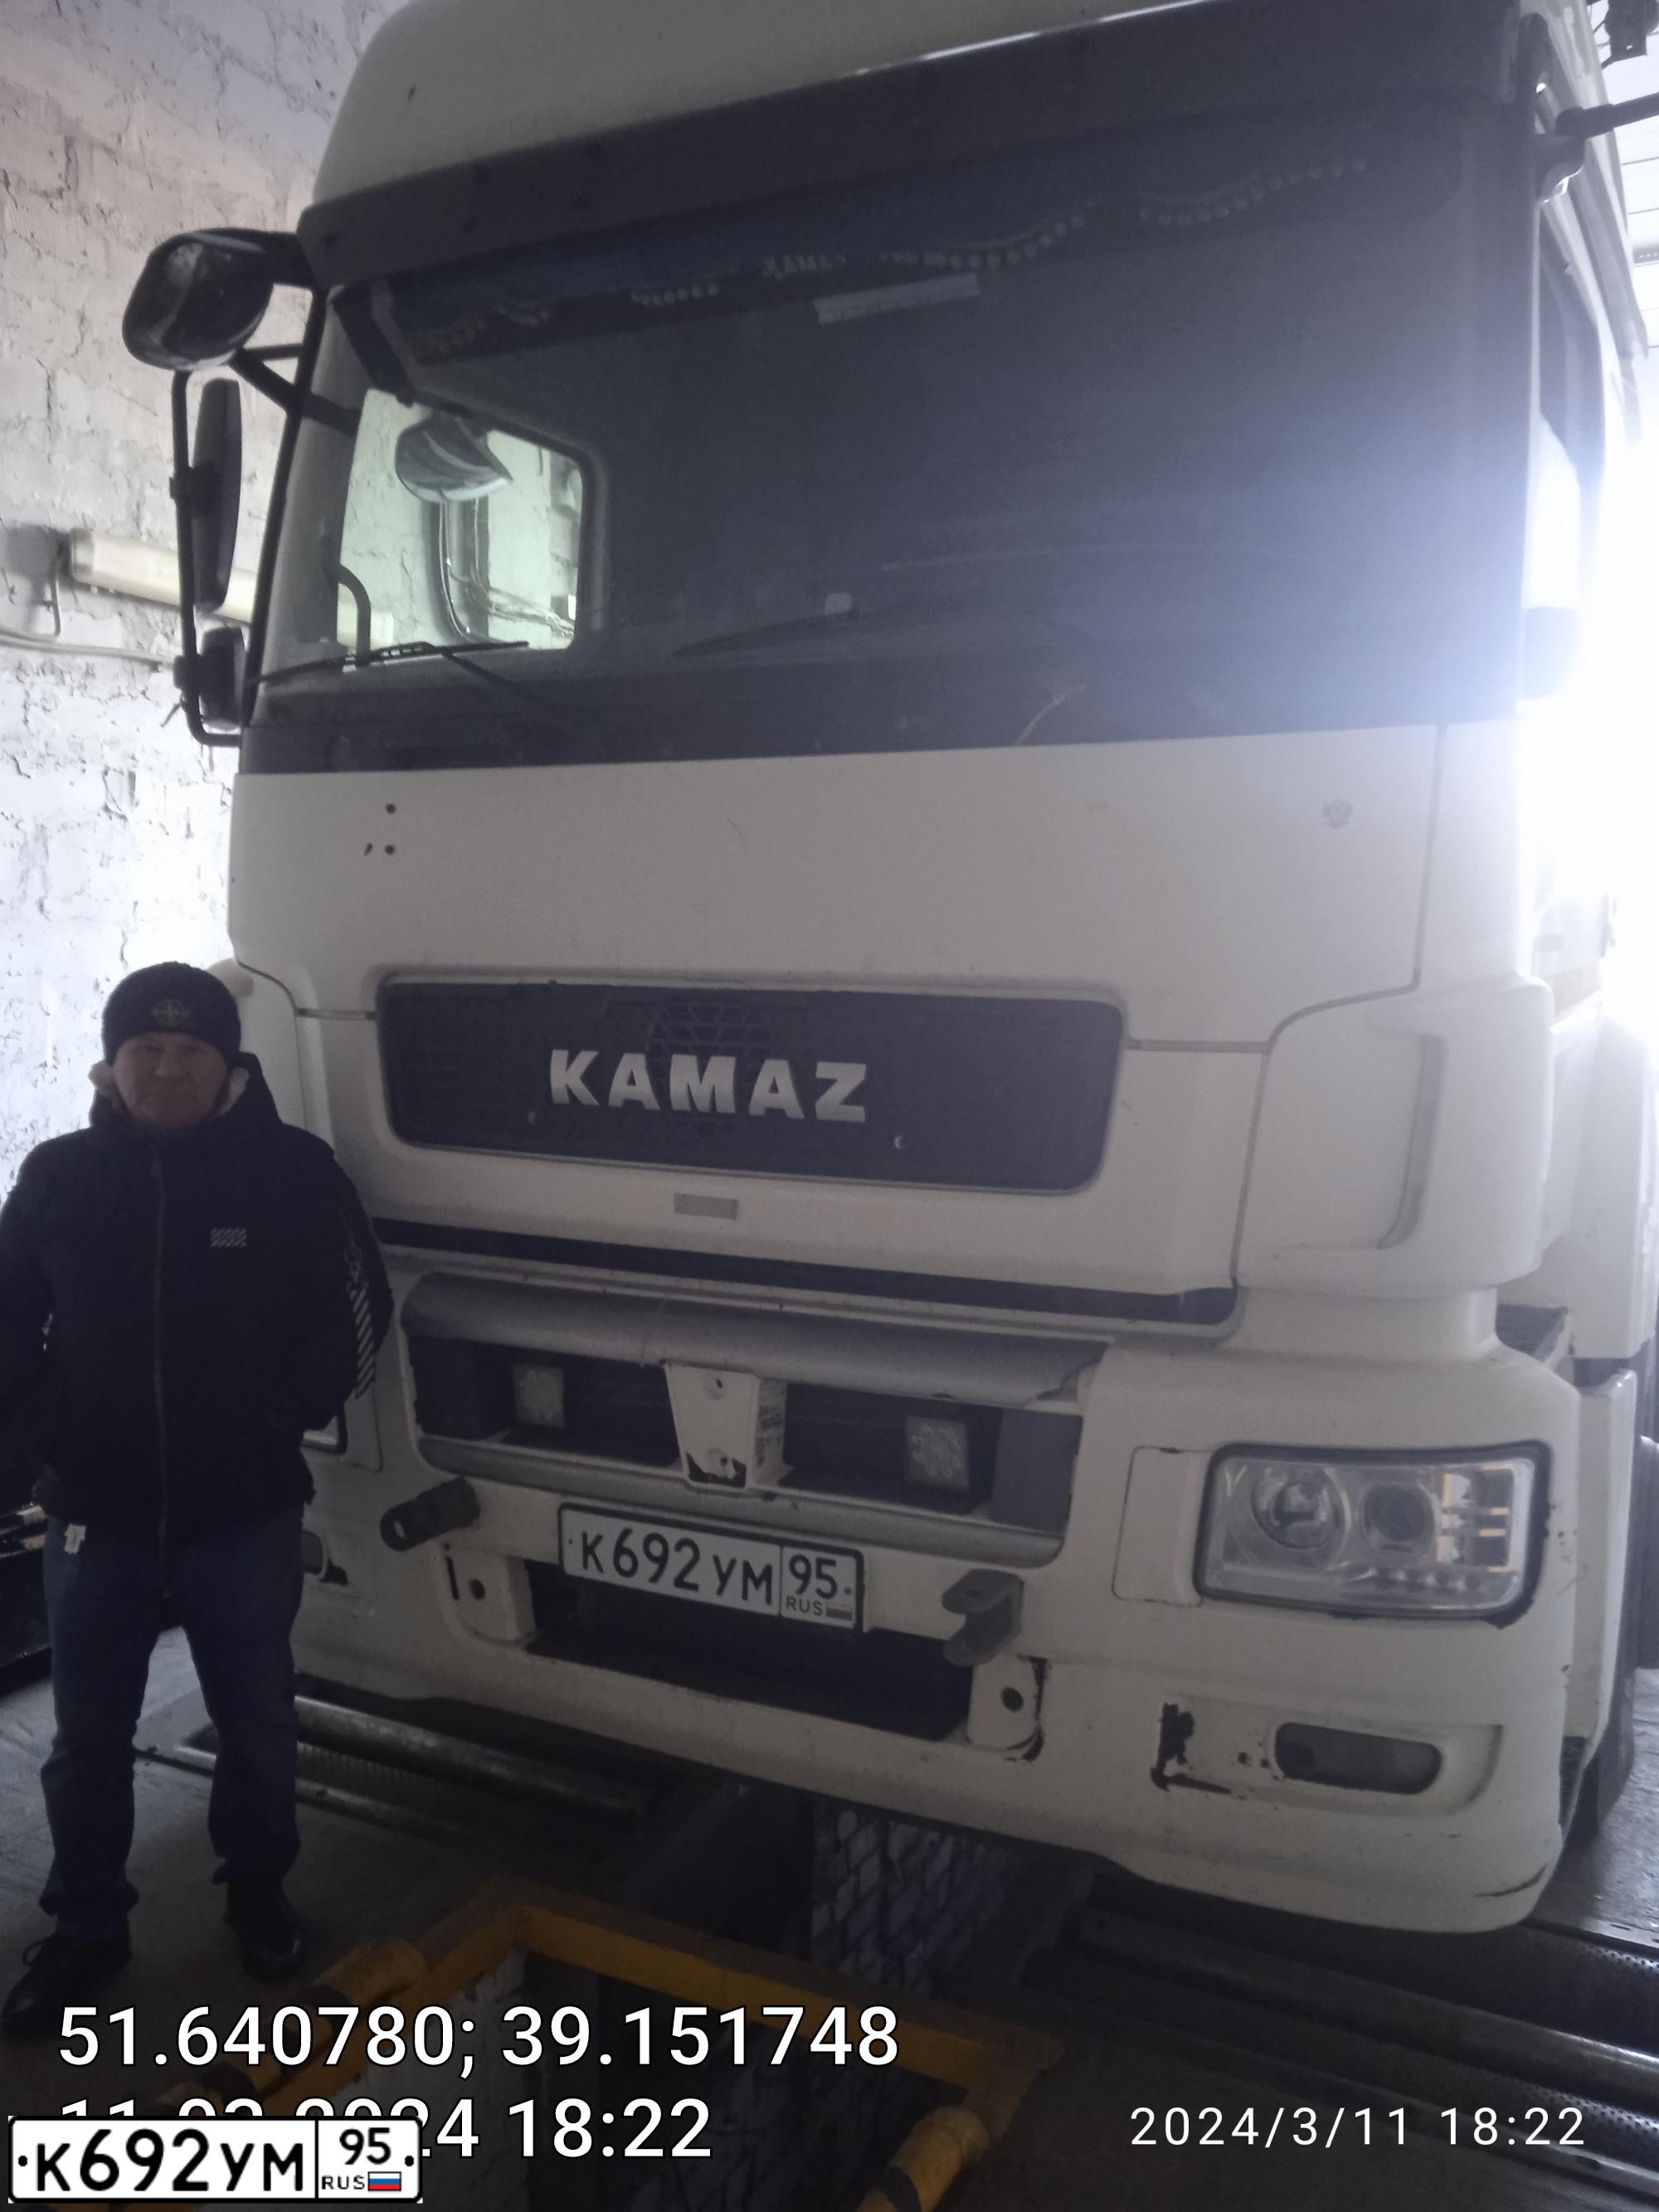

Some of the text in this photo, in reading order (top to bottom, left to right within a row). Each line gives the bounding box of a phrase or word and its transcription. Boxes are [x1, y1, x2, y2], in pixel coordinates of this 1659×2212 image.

[550, 1049, 867, 1123] KAMAZ
[788, 1554, 838, 1599] 95
[786, 1596, 824, 1617] RUS
